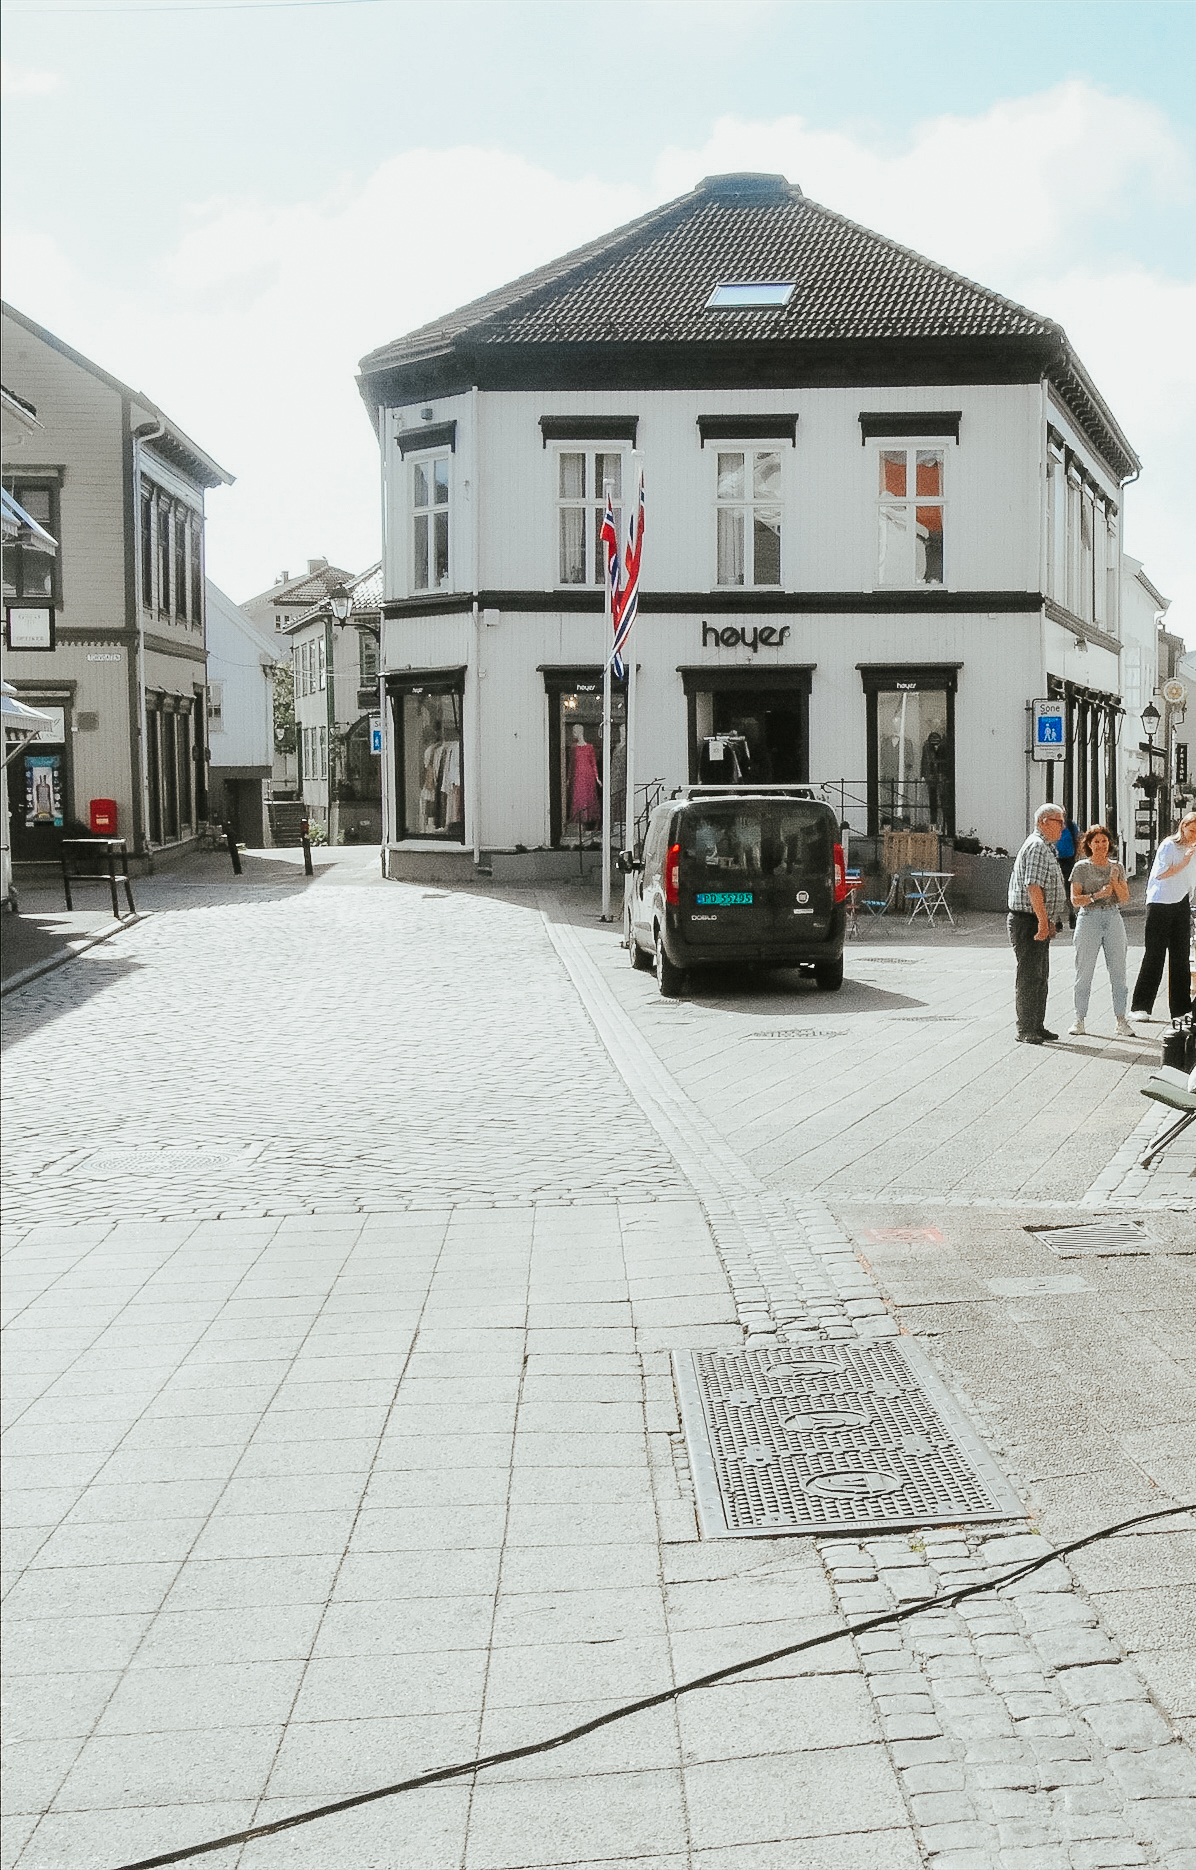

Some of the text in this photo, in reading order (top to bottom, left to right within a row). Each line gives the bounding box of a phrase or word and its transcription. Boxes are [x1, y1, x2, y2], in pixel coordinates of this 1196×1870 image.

[701, 620, 791, 653] høyer
[1039, 704, 1060, 713] Sone
[703, 894, 717, 903] PD
